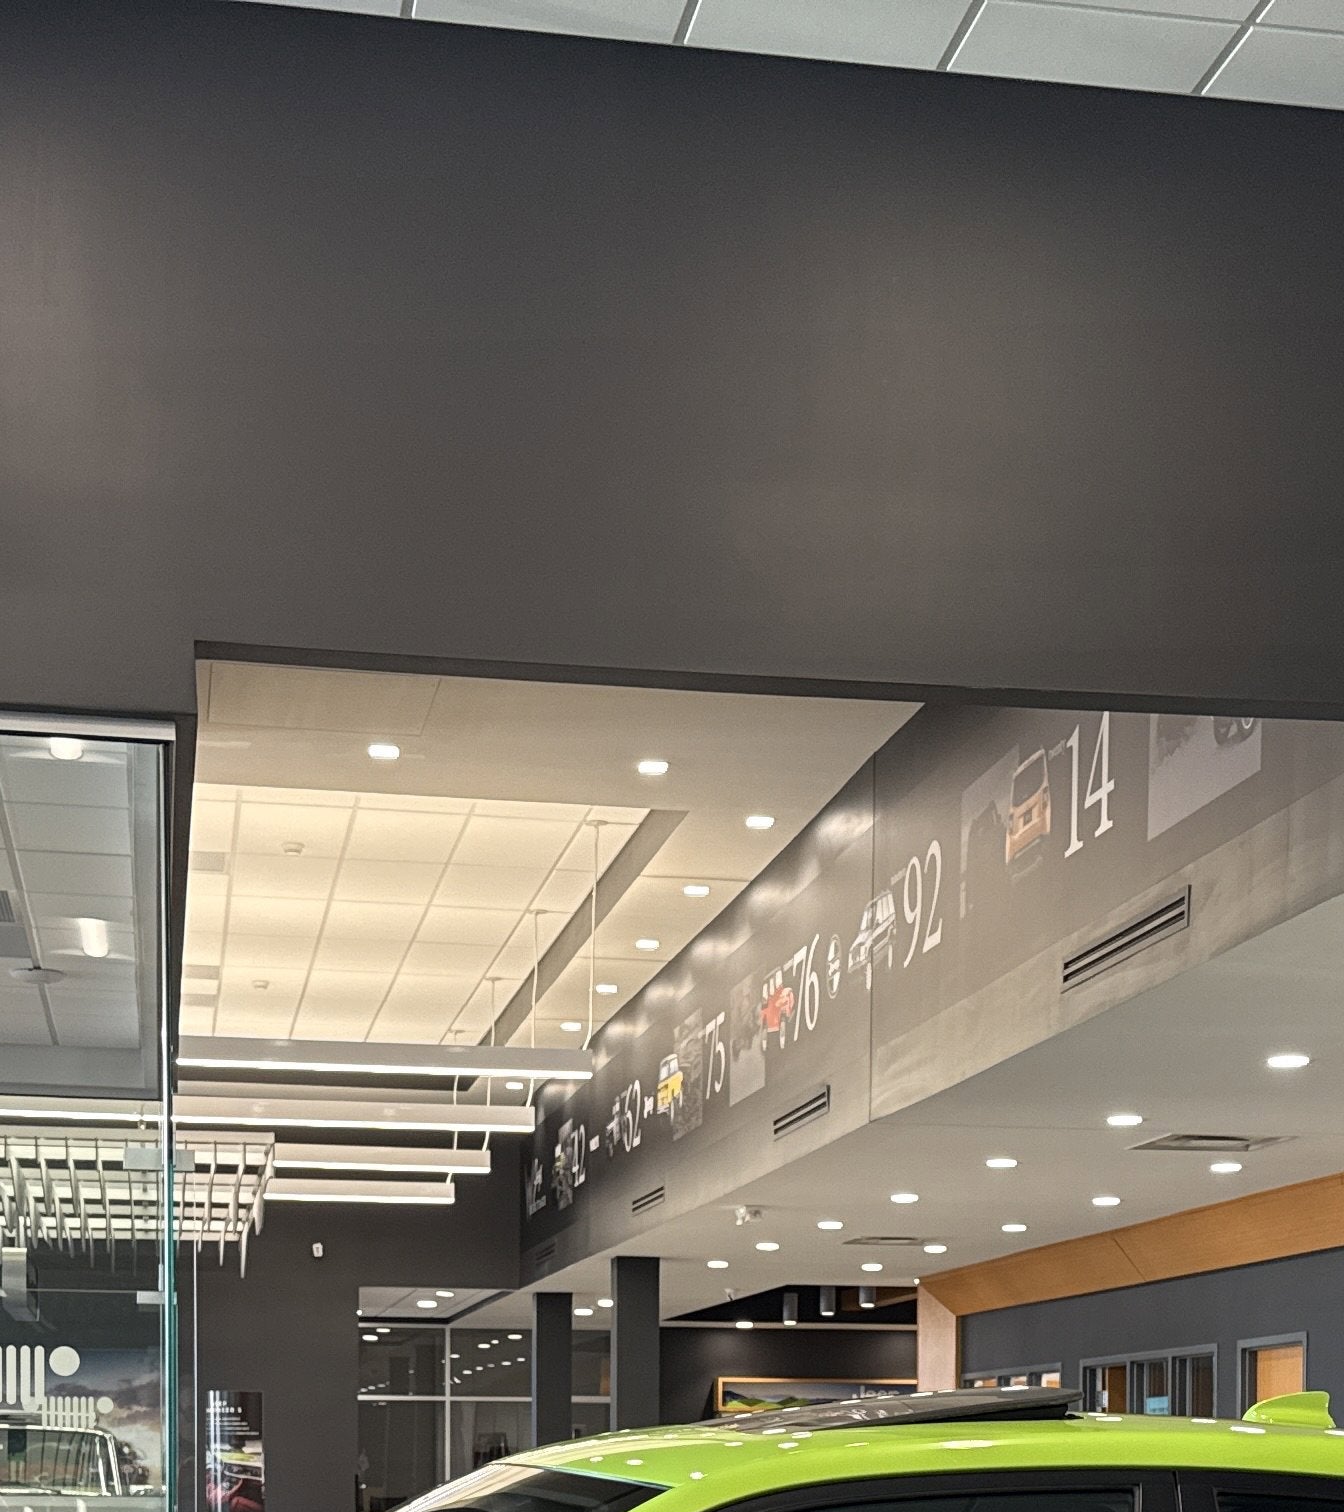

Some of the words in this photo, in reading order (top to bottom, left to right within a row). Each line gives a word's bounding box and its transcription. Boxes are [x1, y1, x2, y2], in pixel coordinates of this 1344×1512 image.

[1064, 711, 1115, 859] 14
[903, 840, 943, 969] 92
[792, 933, 820, 1042] 76
[705, 1011, 726, 1100] 75
[623, 1079, 642, 1153] 62
